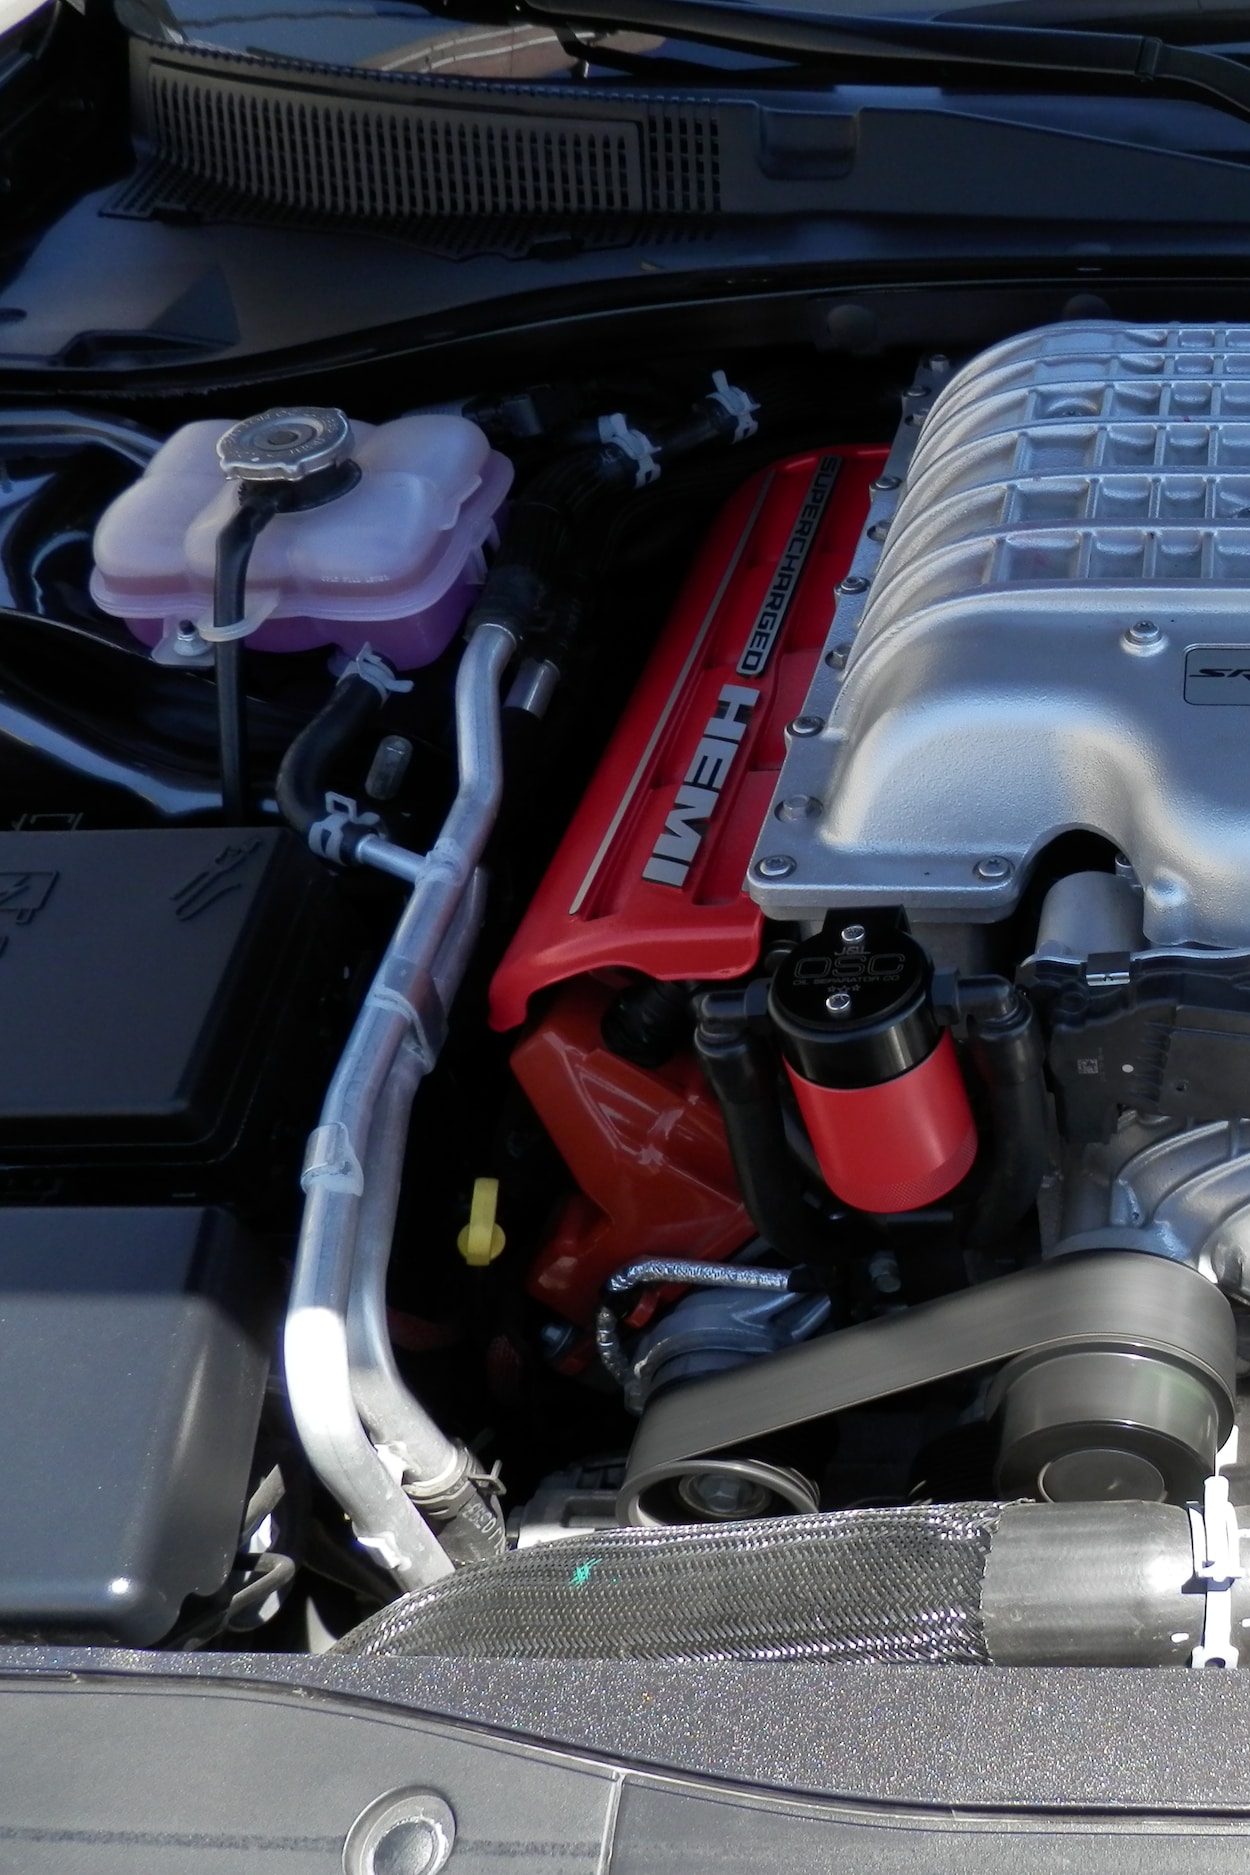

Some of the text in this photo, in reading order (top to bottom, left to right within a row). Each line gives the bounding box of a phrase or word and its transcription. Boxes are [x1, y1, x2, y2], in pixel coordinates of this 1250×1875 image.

[741, 456, 839, 672] SUPERCHARGED
[642, 684, 760, 888] HEMI
[794, 953, 906, 979] OSC
[813, 975, 880, 985] SEPARATOR
